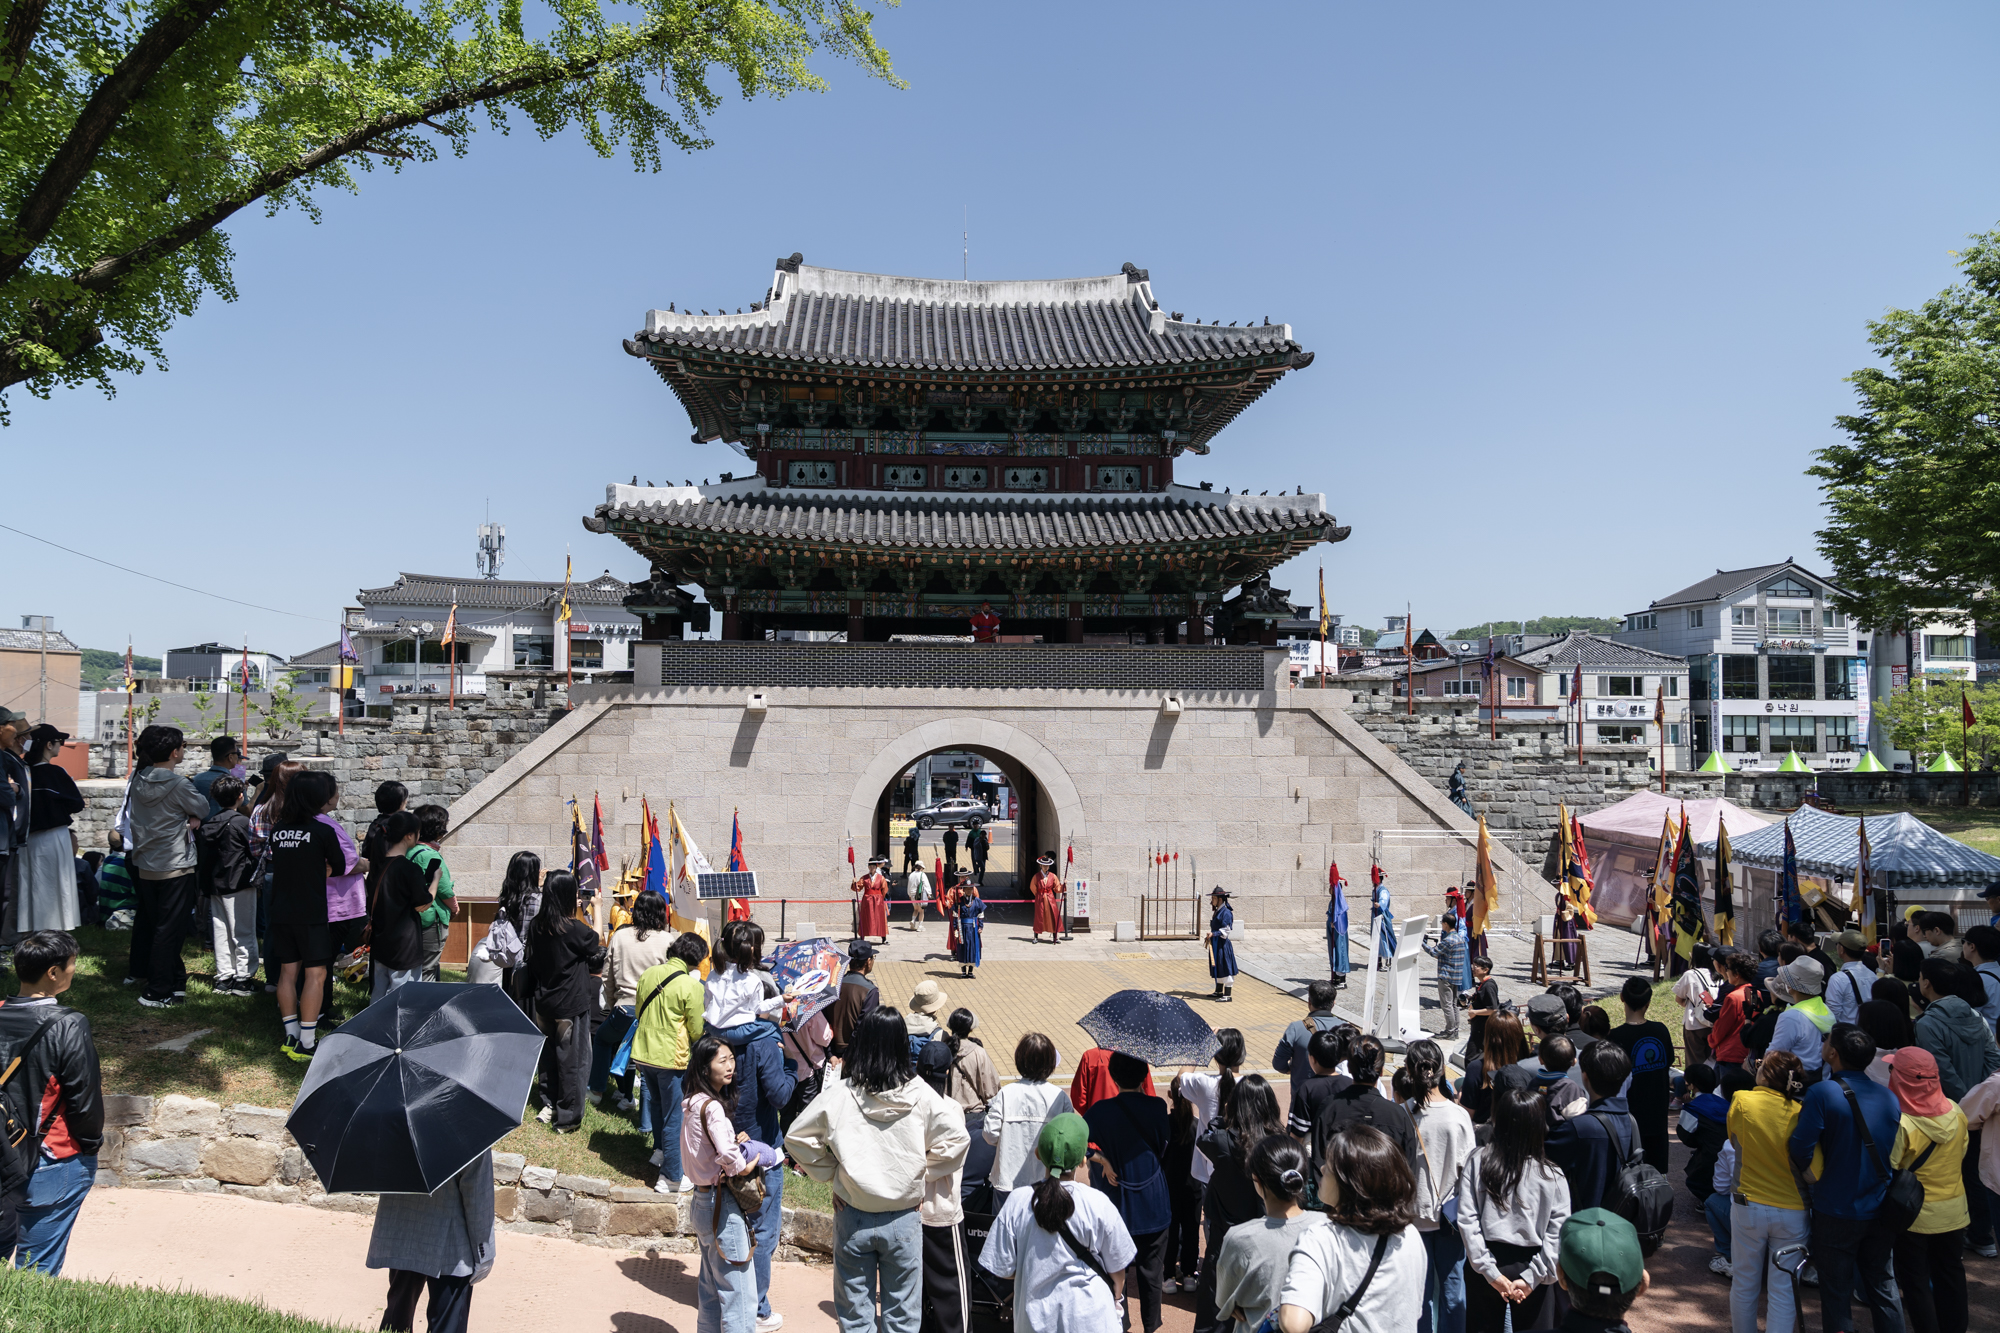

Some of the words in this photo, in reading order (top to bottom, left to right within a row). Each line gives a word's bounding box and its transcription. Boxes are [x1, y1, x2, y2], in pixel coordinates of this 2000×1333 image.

[1597, 705, 1614, 714] 진주
[1777, 703, 1799, 713] 낙원
[272, 830, 311, 843] KOREA
[279, 840, 301, 848] ARMY
[1631, 1061, 1665, 1073] PATAGONIA
